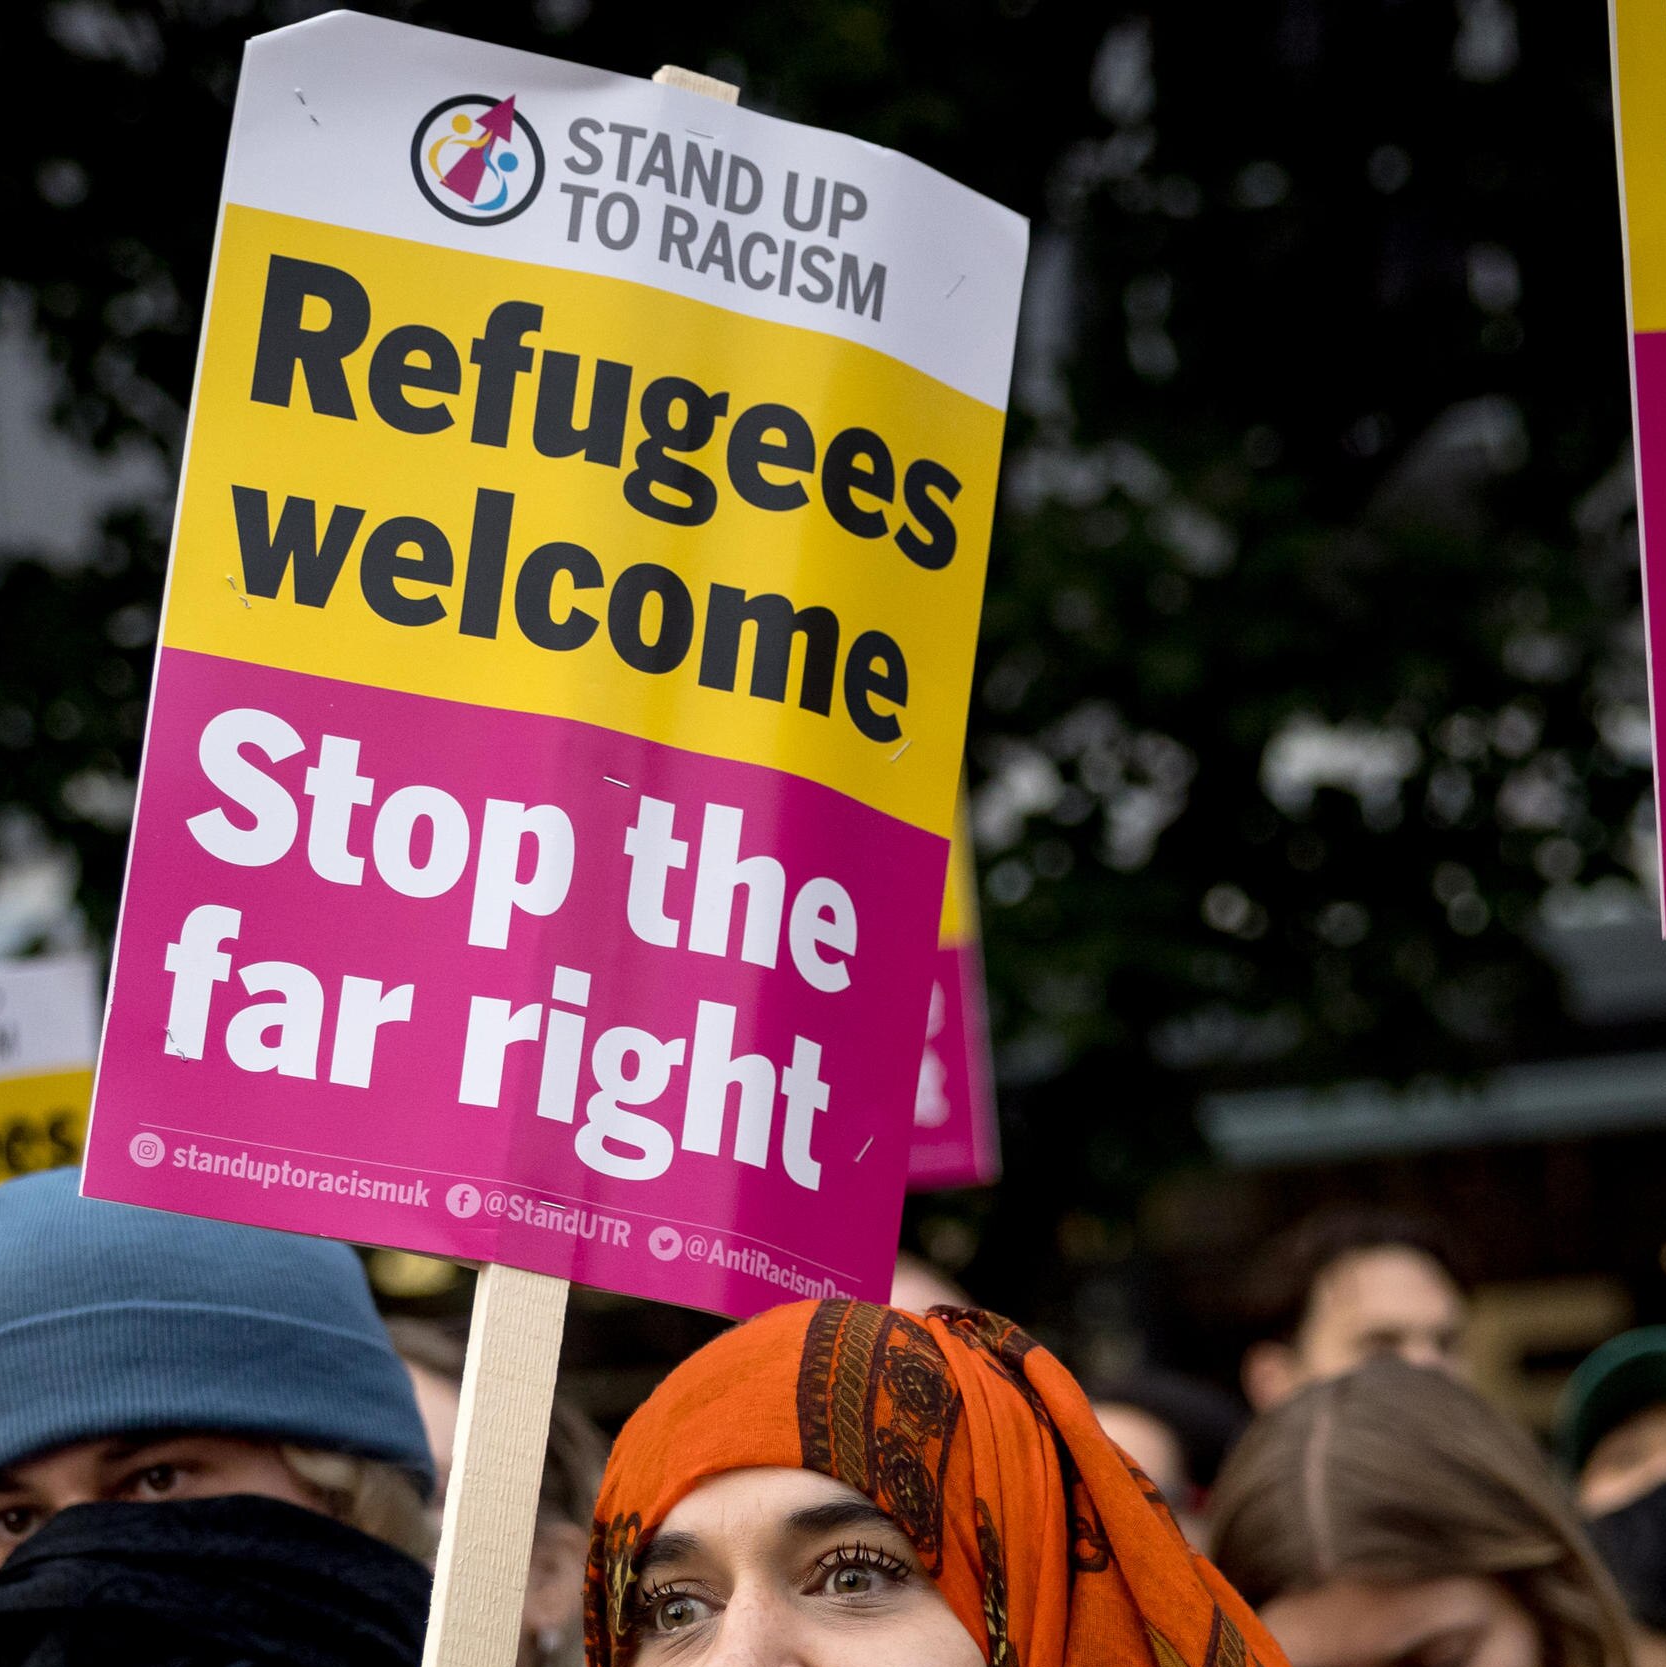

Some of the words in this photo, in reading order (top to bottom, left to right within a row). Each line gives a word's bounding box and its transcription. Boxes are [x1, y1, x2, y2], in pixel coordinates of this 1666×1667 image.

[559, 182, 641, 252] TO
[658, 208, 888, 322] RACISM
[563, 117, 764, 216] STAND
[783, 172, 869, 240] UP
[249, 252, 964, 571] Refugees
[230, 484, 909, 744] welcome
[185, 707, 576, 951] Stop
[624, 794, 860, 994] the
[164, 904, 415, 1090] far
[457, 964, 831, 1192] right
[171, 1142, 431, 1210] standuptoracismuk
[483, 1190, 631, 1250] @StandUTR
